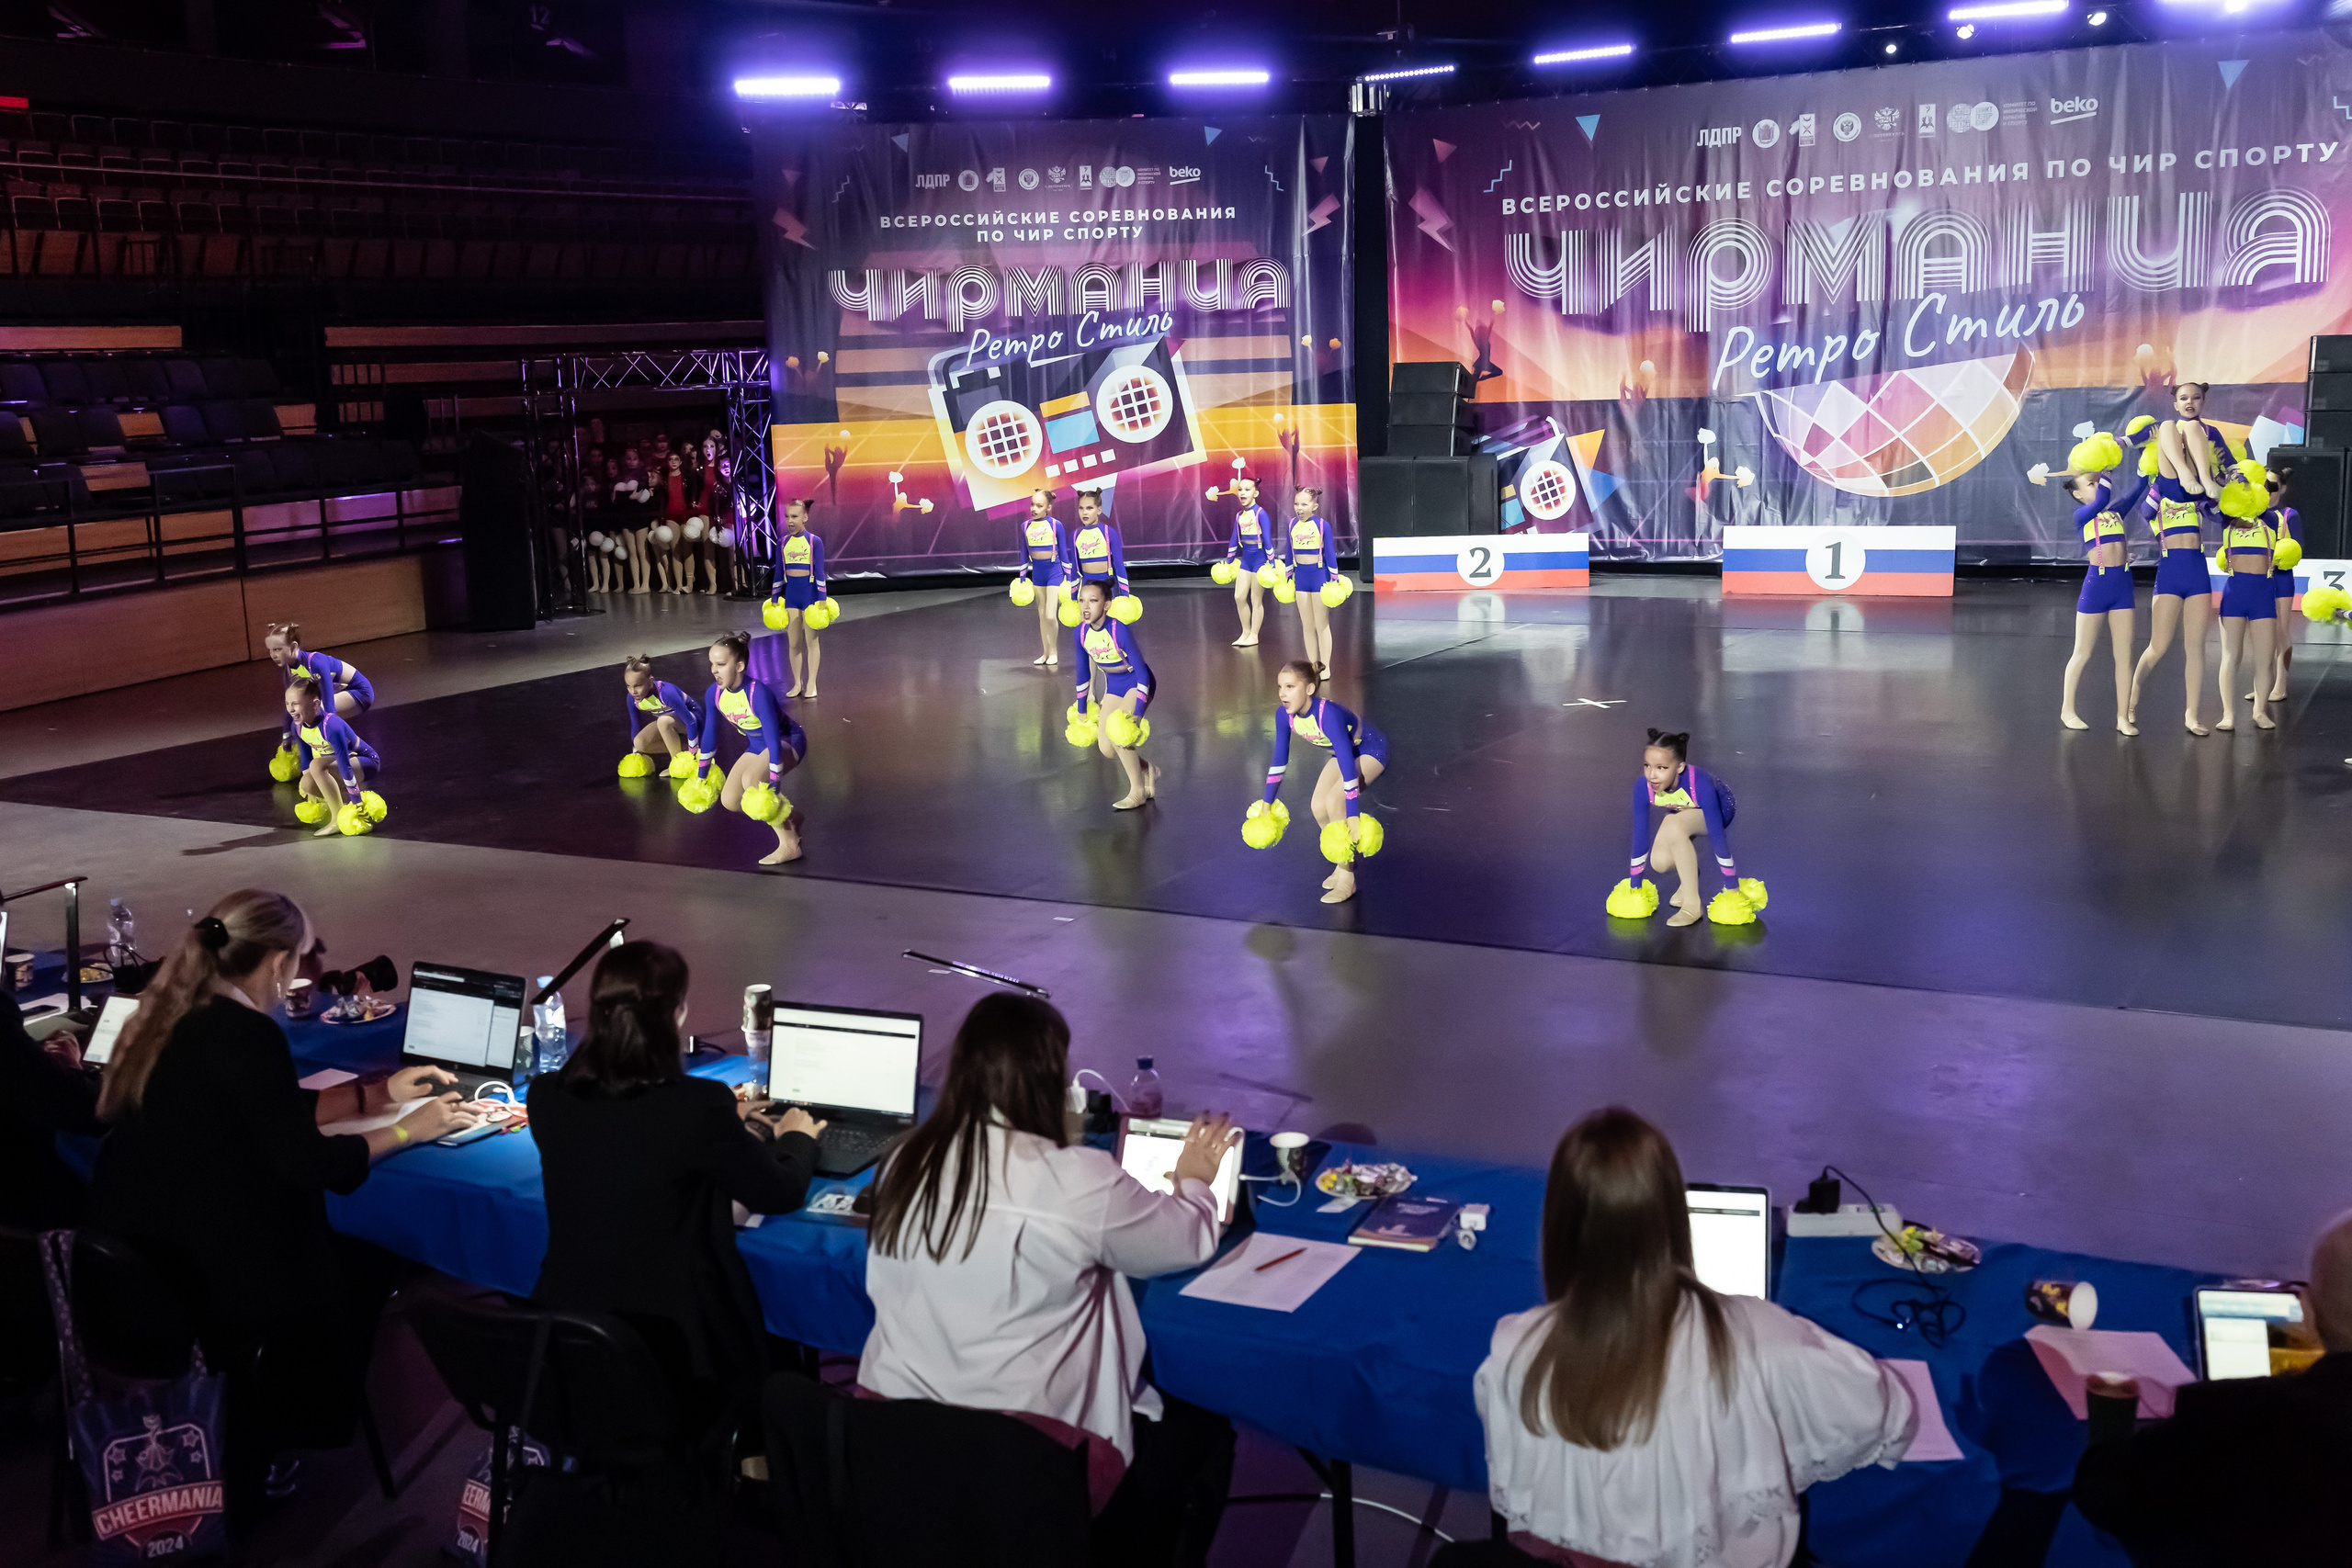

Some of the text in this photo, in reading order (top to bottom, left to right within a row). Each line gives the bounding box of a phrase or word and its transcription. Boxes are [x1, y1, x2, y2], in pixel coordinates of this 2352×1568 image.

[2051, 96, 2098, 115] beko
[1697, 126, 1742, 148] ЛДПР
[915, 173, 950, 189] ЛДПР
[1169, 165, 1201, 178] beko
[1502, 141, 2339, 216] ВСЕРОССИЙСКИЕ СОРЕВНОВАНИЯ ПО ЧИР СПОРТУ
[880, 206, 1238, 229] ВСЕРОССИЙСКИЕ СОРЕВНОВАНИЯ
[977, 224, 1144, 243] ПО ЧИР СПОРТУ
[964, 310, 1174, 368] Ретро Стиль
[1712, 292, 2085, 390] Ретро Стиль
[1468, 547, 1493, 579] 2
[1824, 541, 1846, 580] 1
[2323, 570, 2346, 591] 3
[96, 1485, 223, 1534] CHEERMANIA
[147, 1535, 184, 1558] 2024
[457, 1529, 480, 1553] 2024
